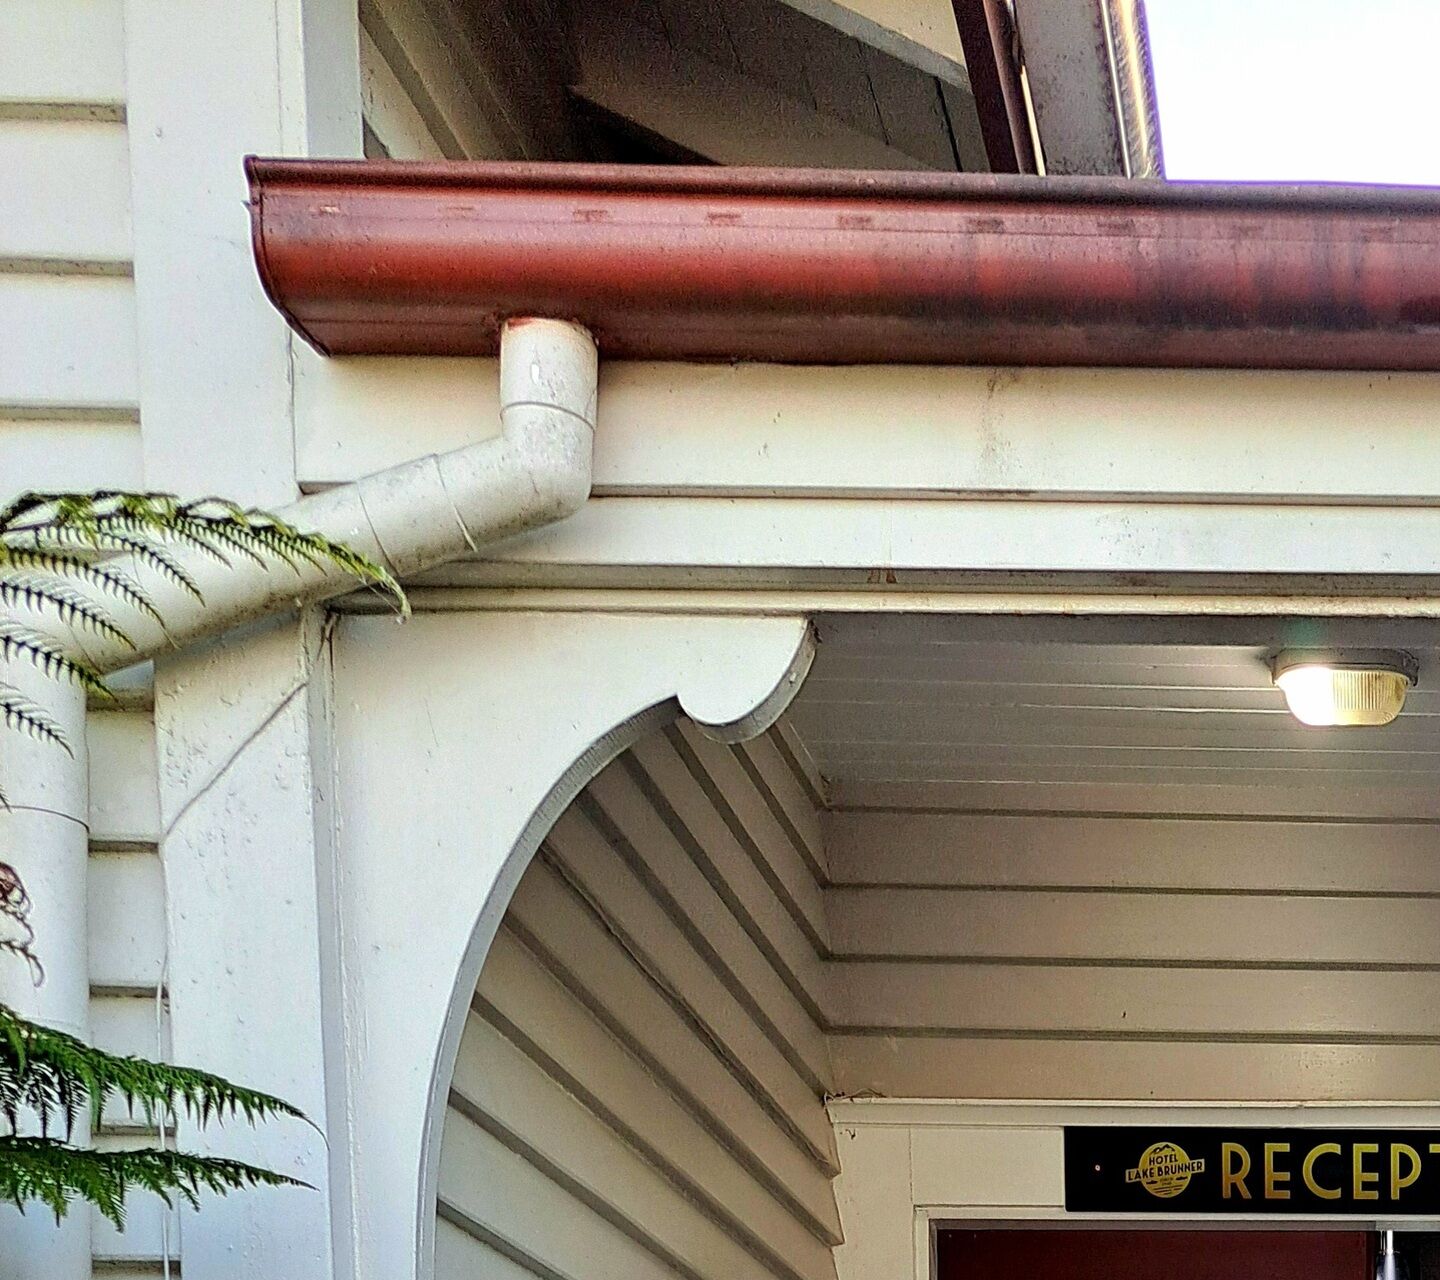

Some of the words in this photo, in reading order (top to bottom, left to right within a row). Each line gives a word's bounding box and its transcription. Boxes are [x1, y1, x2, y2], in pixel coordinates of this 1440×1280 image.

[1148, 1153, 1179, 1166] HOTEL
[1127, 1167, 1157, 1181] LAKE
[1156, 1161, 1203, 1177] BRUNNER
